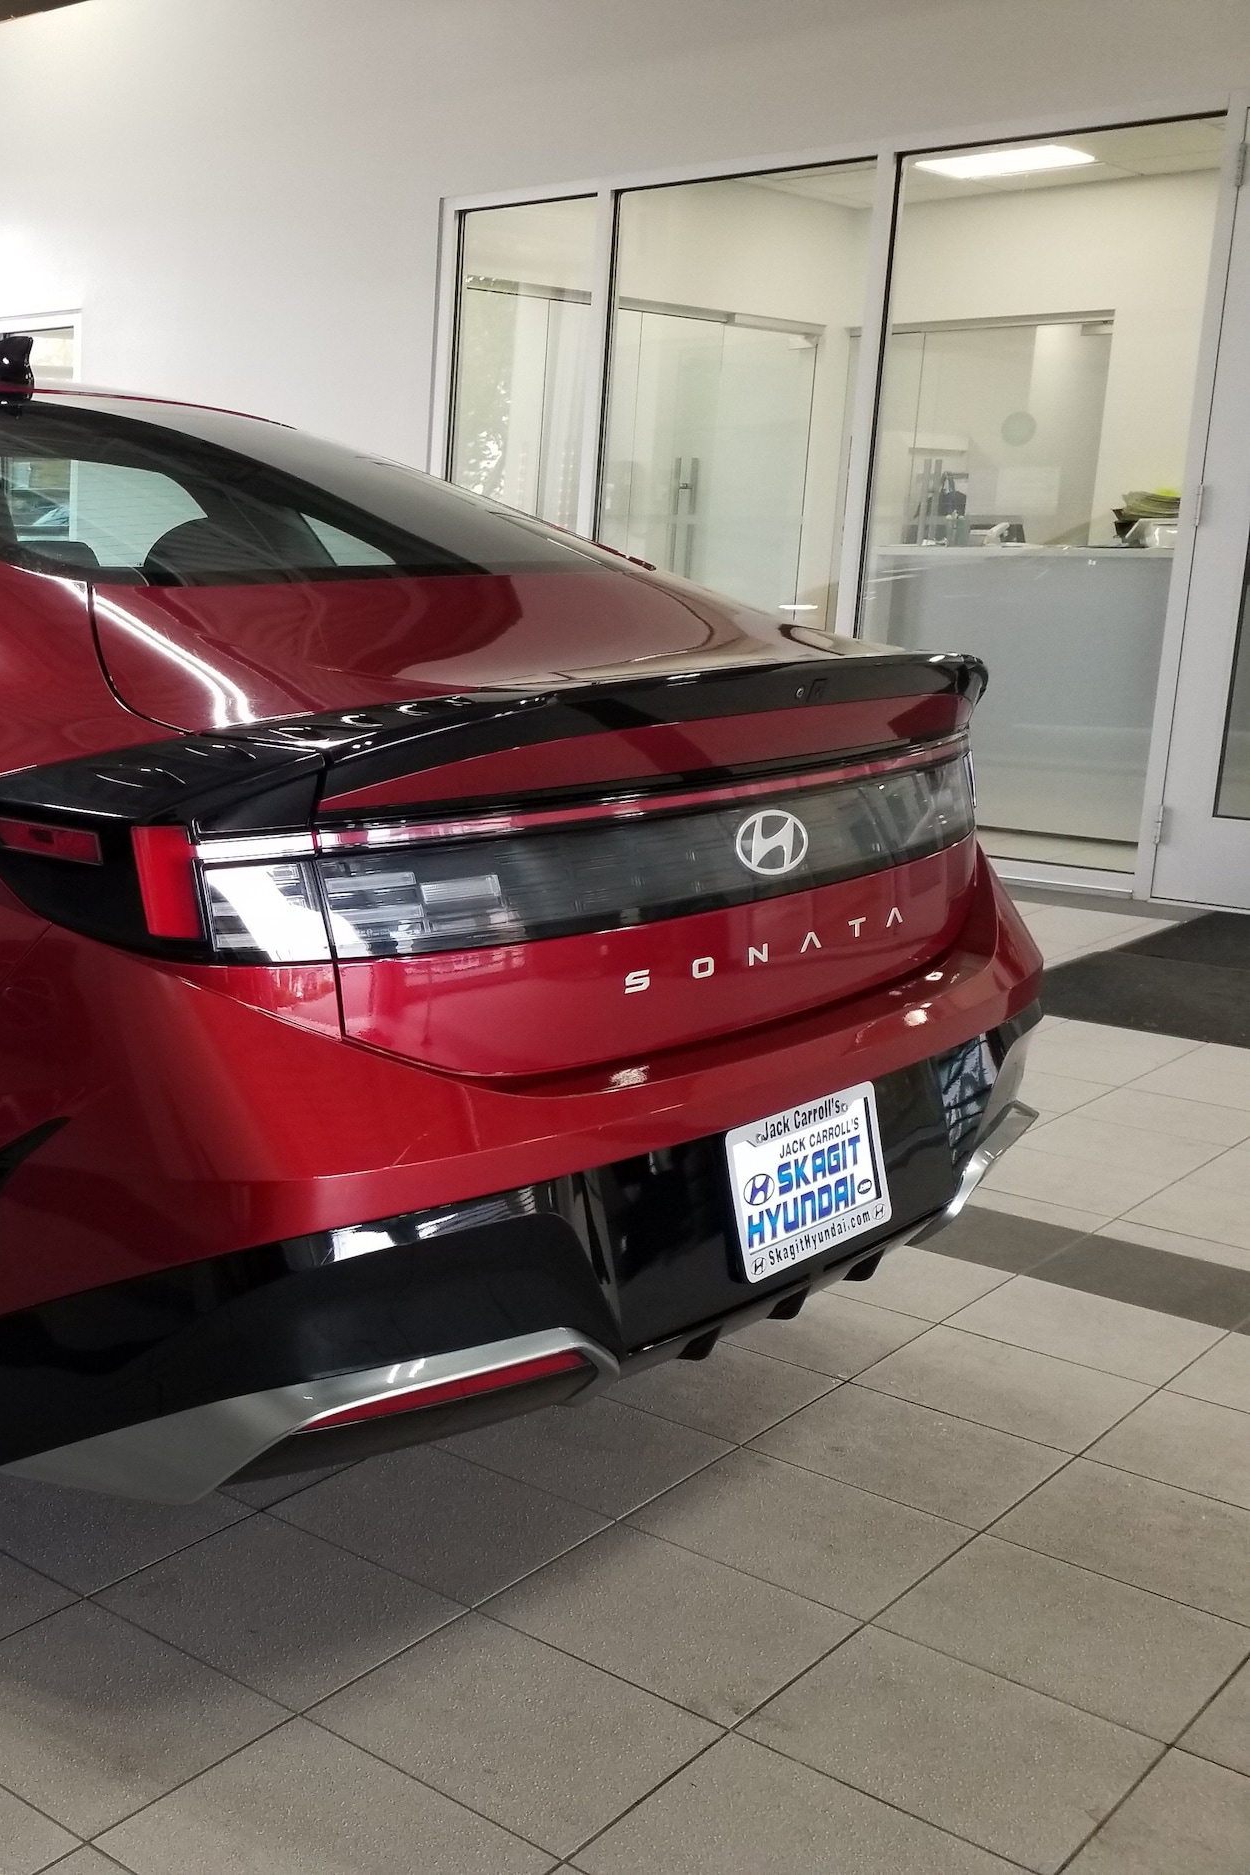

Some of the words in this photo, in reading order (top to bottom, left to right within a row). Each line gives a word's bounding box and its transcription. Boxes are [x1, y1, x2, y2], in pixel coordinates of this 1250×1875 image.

[624, 906, 904, 994] SONATA
[763, 1115, 791, 1141] Jack
[793, 1097, 841, 1130] Carroll's
[779, 1137, 806, 1159] JACK
[809, 1117, 860, 1147] CARROLL'S
[777, 1134, 861, 1197] SKAGIT
[747, 1173, 857, 1248] HYUNDAI
[768, 1210, 871, 1266] SkagitHyundai.com
